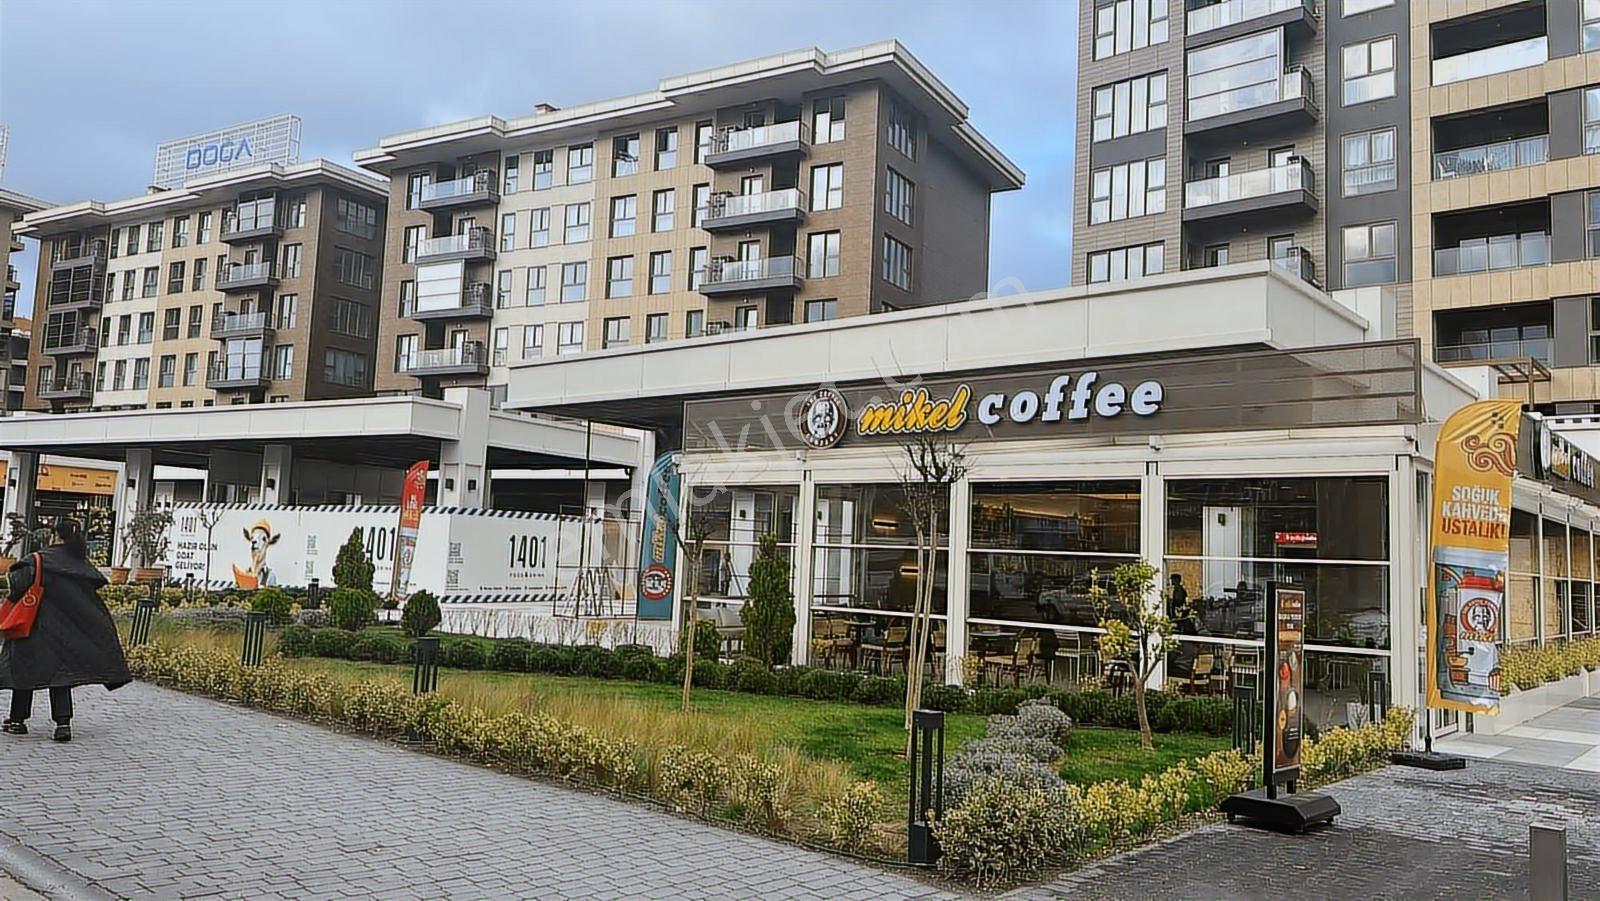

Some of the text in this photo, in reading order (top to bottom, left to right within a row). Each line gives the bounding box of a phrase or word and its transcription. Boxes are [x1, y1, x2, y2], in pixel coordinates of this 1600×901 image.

[859, 372, 1163, 434] mikel coffee
[1452, 485, 1500, 504] SOĞUK
[1442, 517, 1506, 539] USTALIK!
[510, 535, 546, 568] 1401
